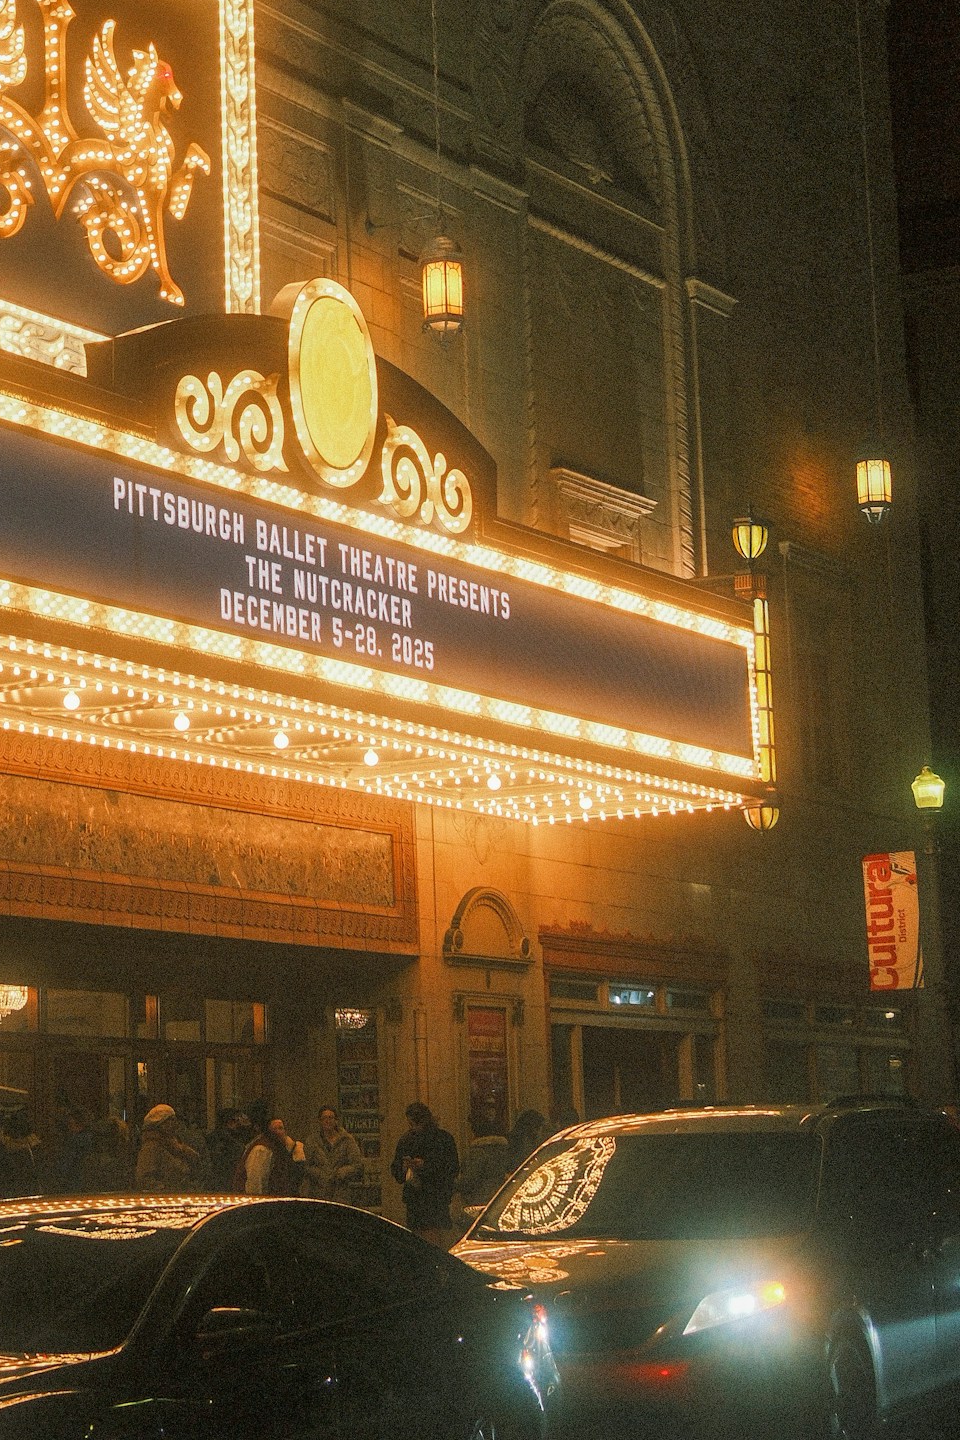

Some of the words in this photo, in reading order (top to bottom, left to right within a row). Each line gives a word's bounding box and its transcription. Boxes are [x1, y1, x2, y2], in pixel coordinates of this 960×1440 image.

[113, 477, 245, 545] PITTSBURGH
[256, 519, 328, 568] BALLET
[339, 543, 418, 594] THEATRE
[427, 570, 511, 620] PRESENTS
[220, 589, 321, 643] DECEMBER
[332, 616, 382, 657] 5-28,
[391, 632, 435, 671] 2025
[245, 555, 282, 594] THE
[293, 569, 413, 629] NUTCRACKER
[897, 909, 907, 943] District
